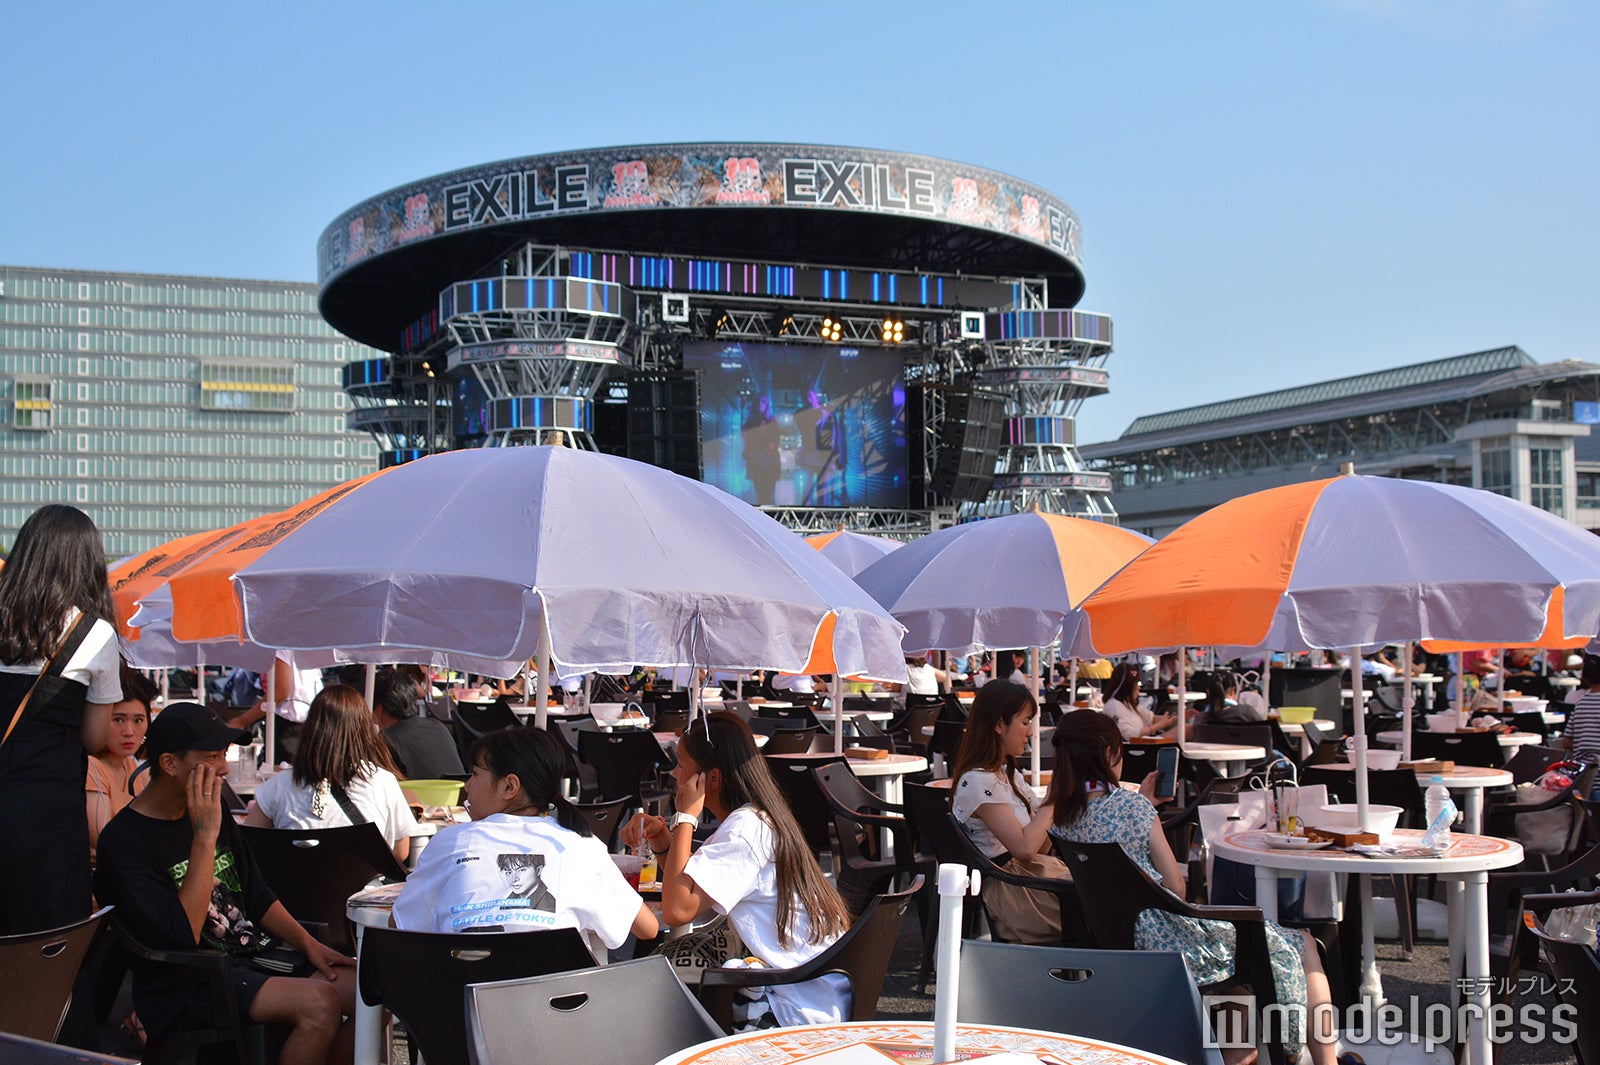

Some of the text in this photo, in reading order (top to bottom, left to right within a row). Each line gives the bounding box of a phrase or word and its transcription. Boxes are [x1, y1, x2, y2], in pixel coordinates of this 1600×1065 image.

[444, 164, 590, 232] EXILE
[783, 159, 937, 215] EXILE
[452, 913, 556, 927] BATTLE OF TOKYO
